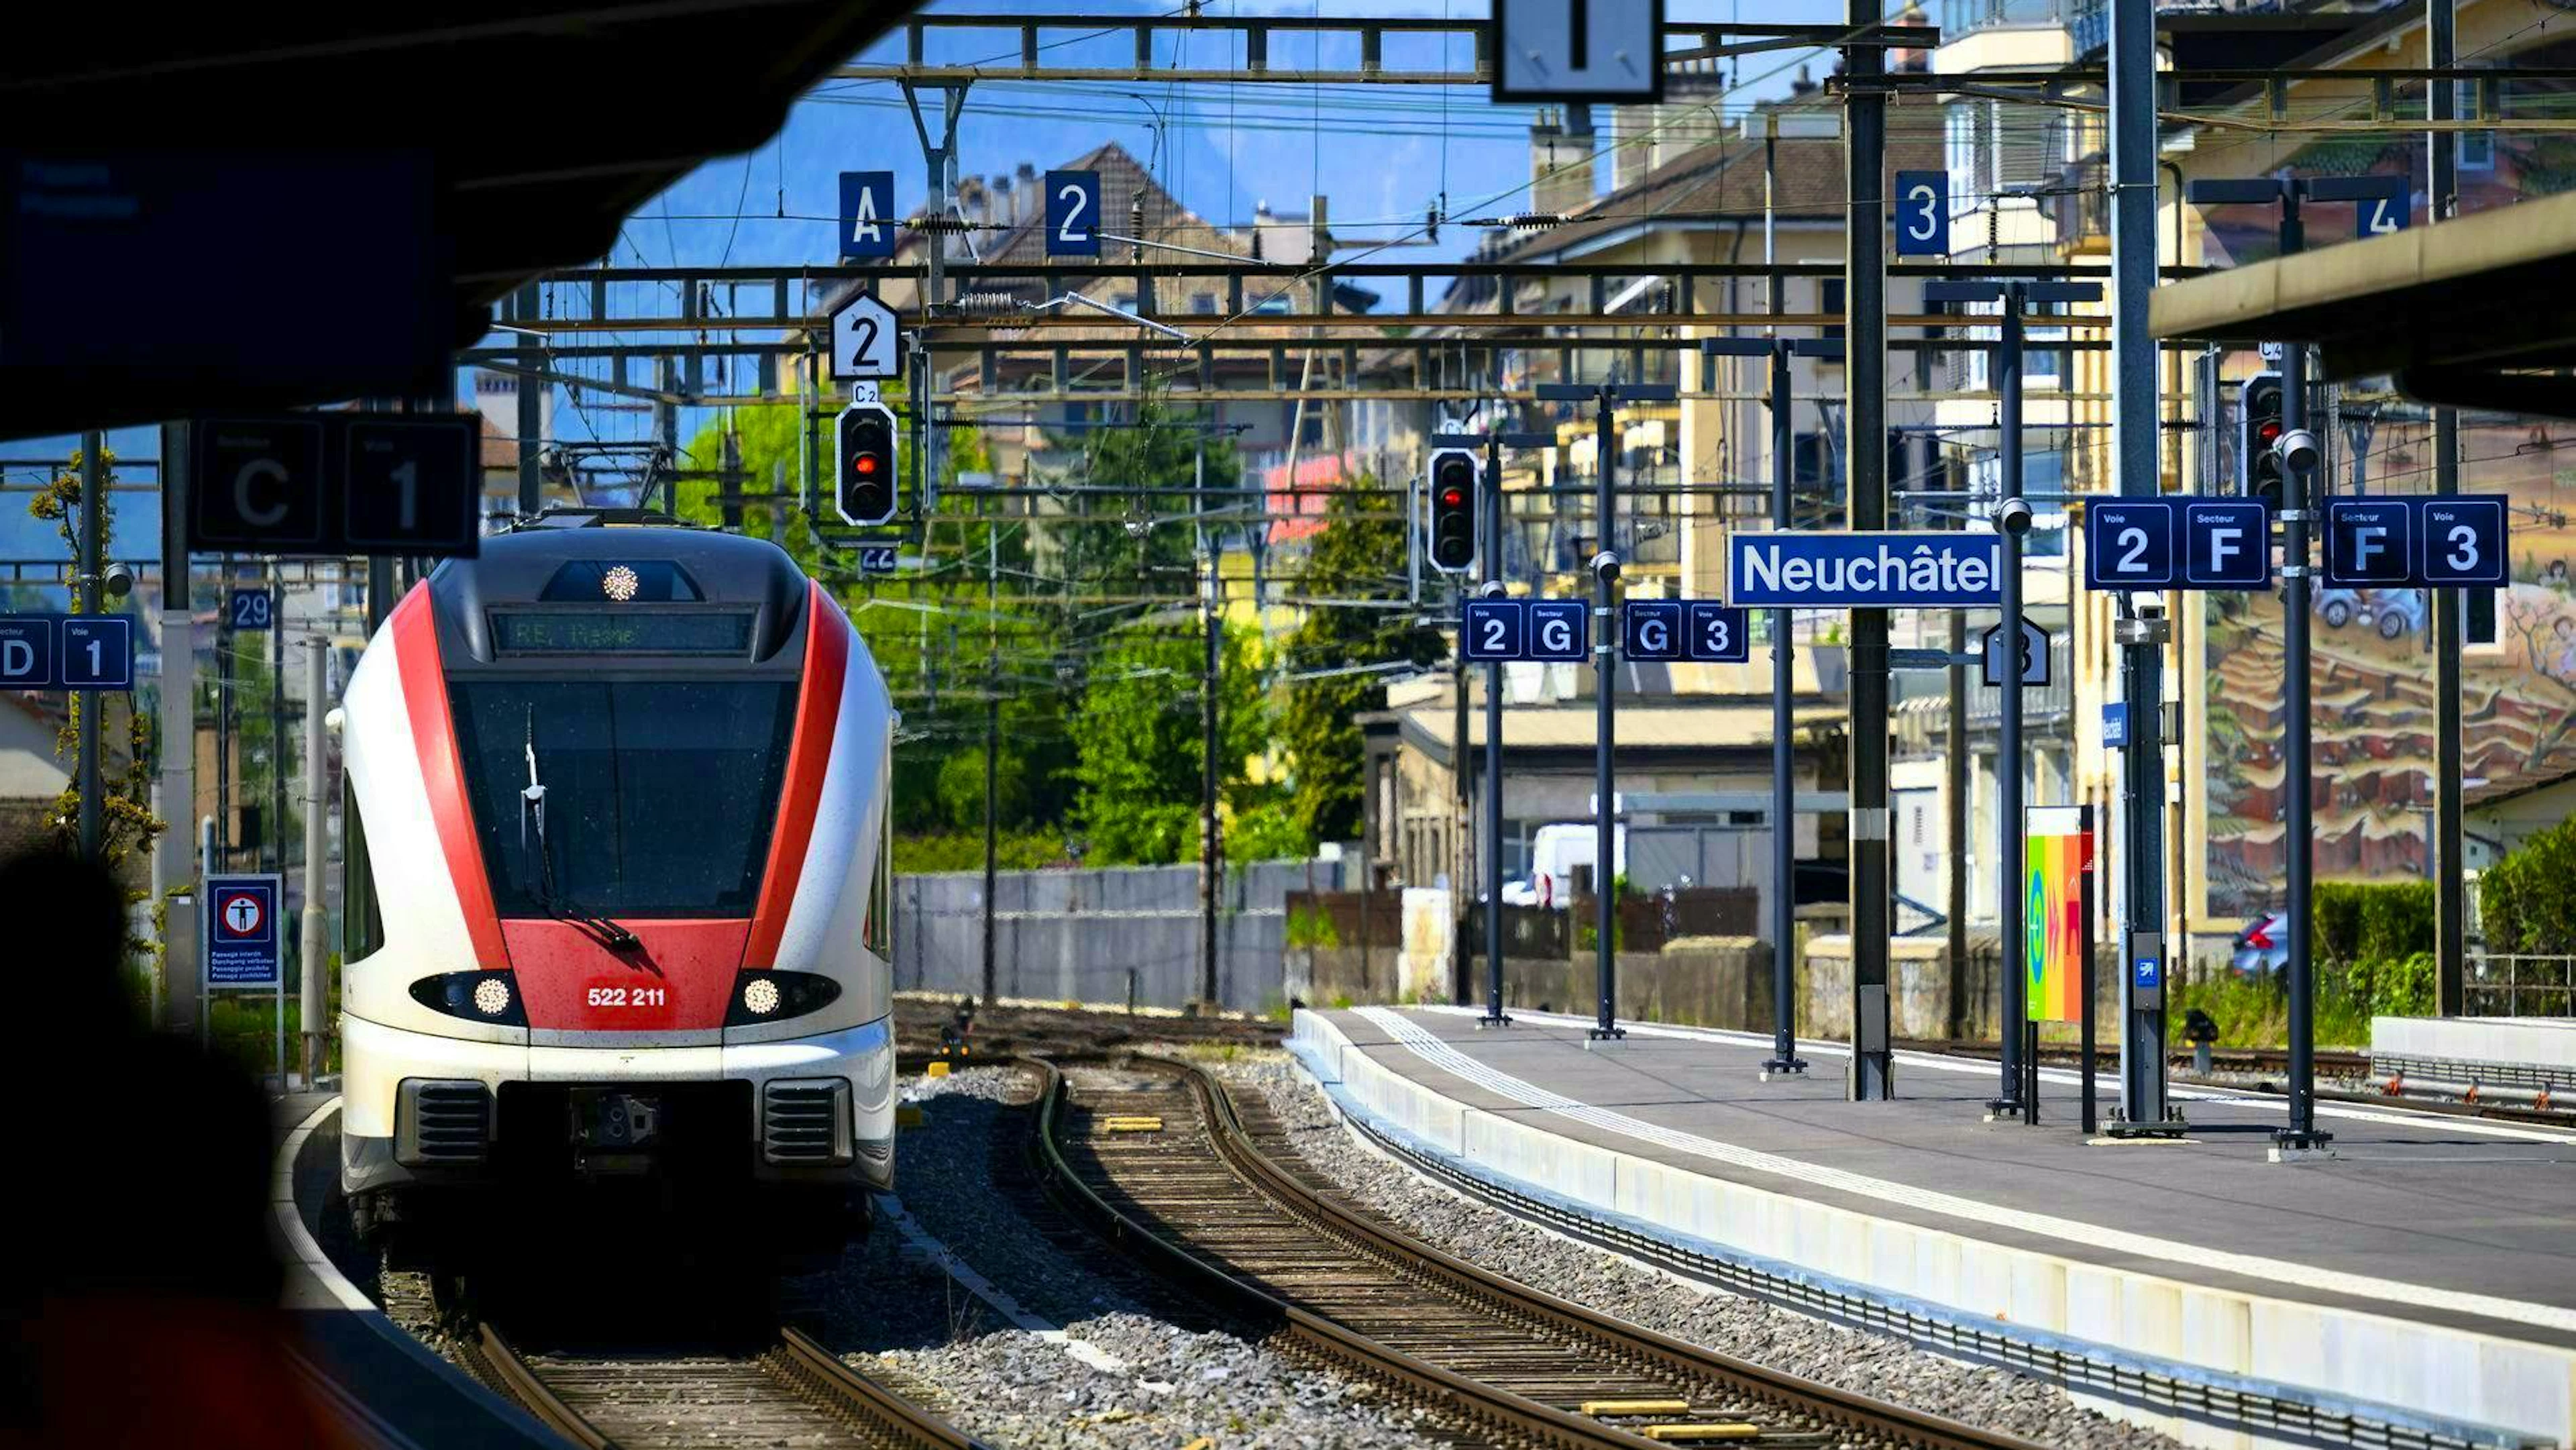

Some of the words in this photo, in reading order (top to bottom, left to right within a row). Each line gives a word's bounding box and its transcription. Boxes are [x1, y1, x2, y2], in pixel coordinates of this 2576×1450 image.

[853, 186, 881, 242] A
[1059, 185, 1087, 242] 2
[1908, 185, 1937, 240] 3
[2370, 198, 2398, 233] 4
[851, 317, 879, 367] 2
[233, 458, 288, 526] C
[390, 461, 416, 529] 1
[2103, 514, 2125, 523] Voie
[2197, 514, 2235, 523] Secteur
[2433, 512, 2455, 521] Voie
[2116, 527, 2149, 572] 2
[2211, 528, 2243, 572] F
[2355, 527, 2387, 571] F
[2447, 525, 2479, 571] 3
[1743, 544, 2000, 592] Neuchâtel
[236, 594, 268, 626] 29
[0, 627, 24, 636] ecteur
[71, 627, 89, 636] Voie
[1483, 619, 1505, 650] 2
[1542, 619, 1571, 651] G
[1640, 619, 1668, 651] G
[1707, 619, 1729, 651] 3
[3, 639, 34, 676] D
[86, 639, 101, 676] 1
[588, 988, 627, 1006] 522
[632, 988, 664, 1006] 211
